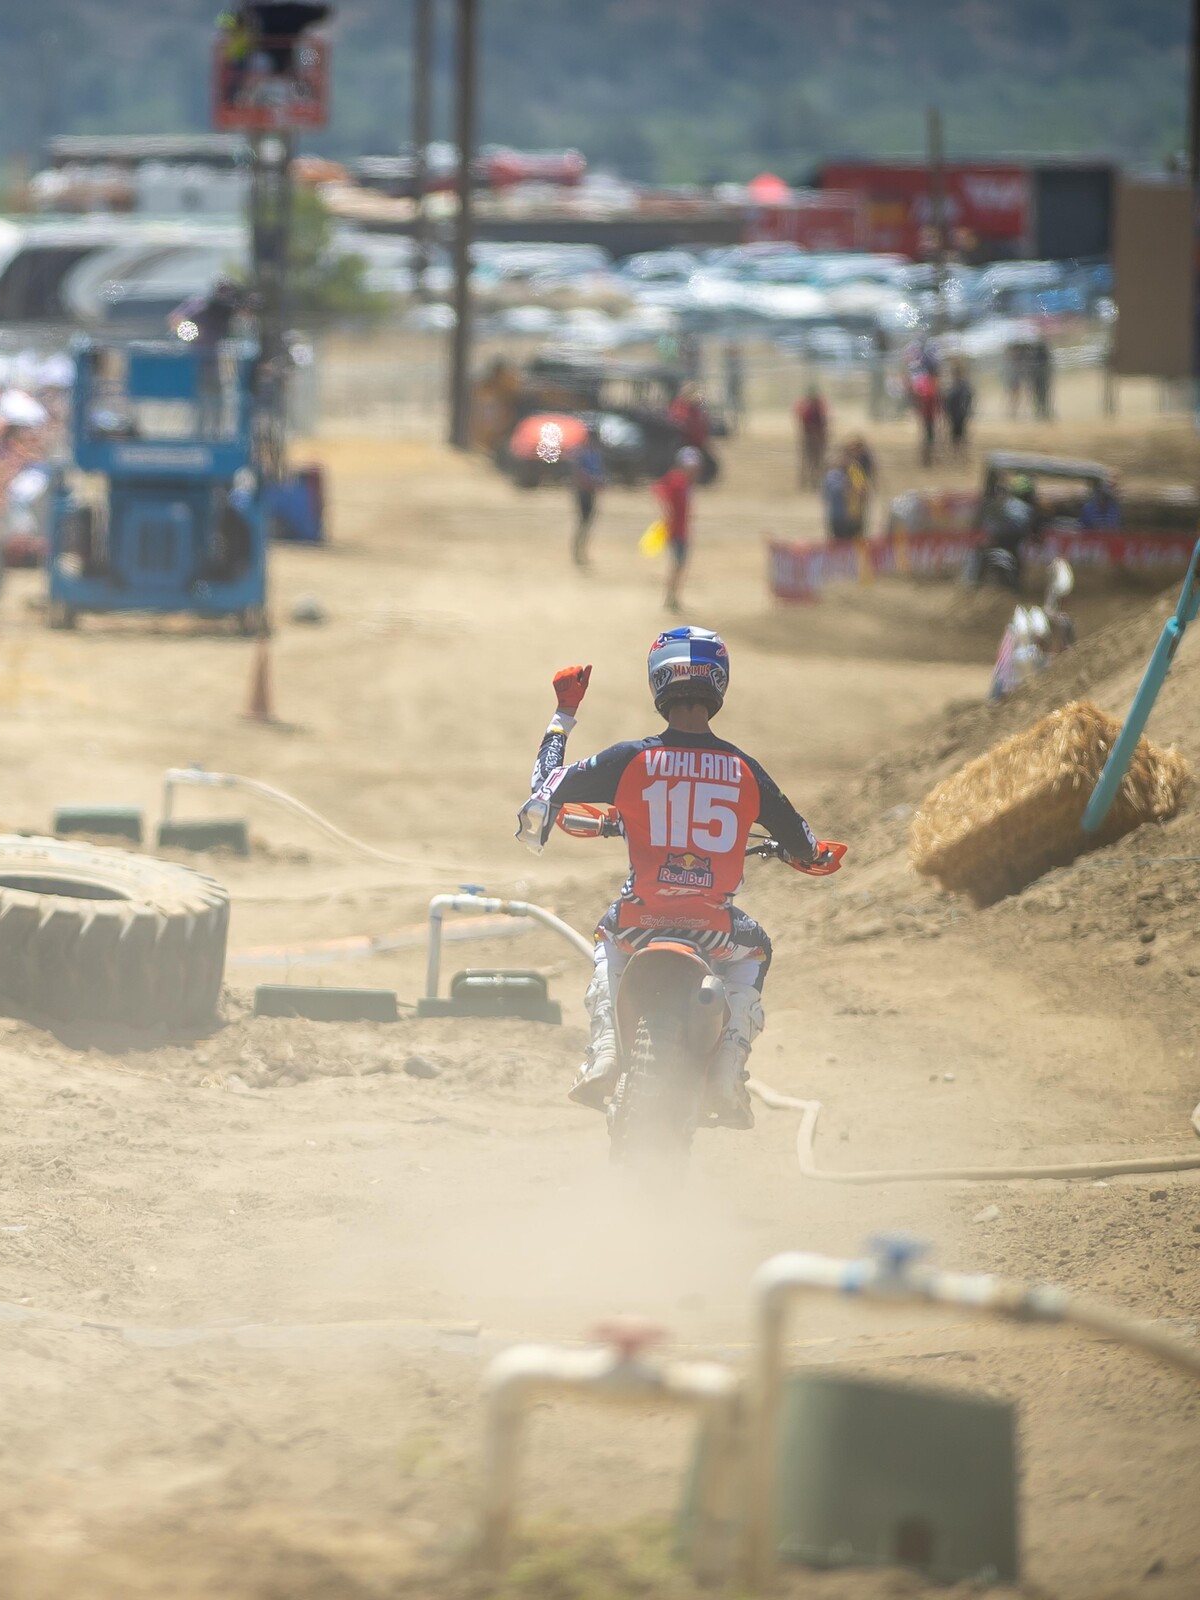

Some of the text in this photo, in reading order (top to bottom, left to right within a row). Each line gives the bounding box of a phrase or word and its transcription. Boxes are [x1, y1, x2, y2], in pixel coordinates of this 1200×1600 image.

[673, 663, 711, 677] MAXIMUS
[645, 750, 742, 784] VOHLAND
[642, 780, 740, 853] 115
[660, 868, 712, 887] Red Bull
